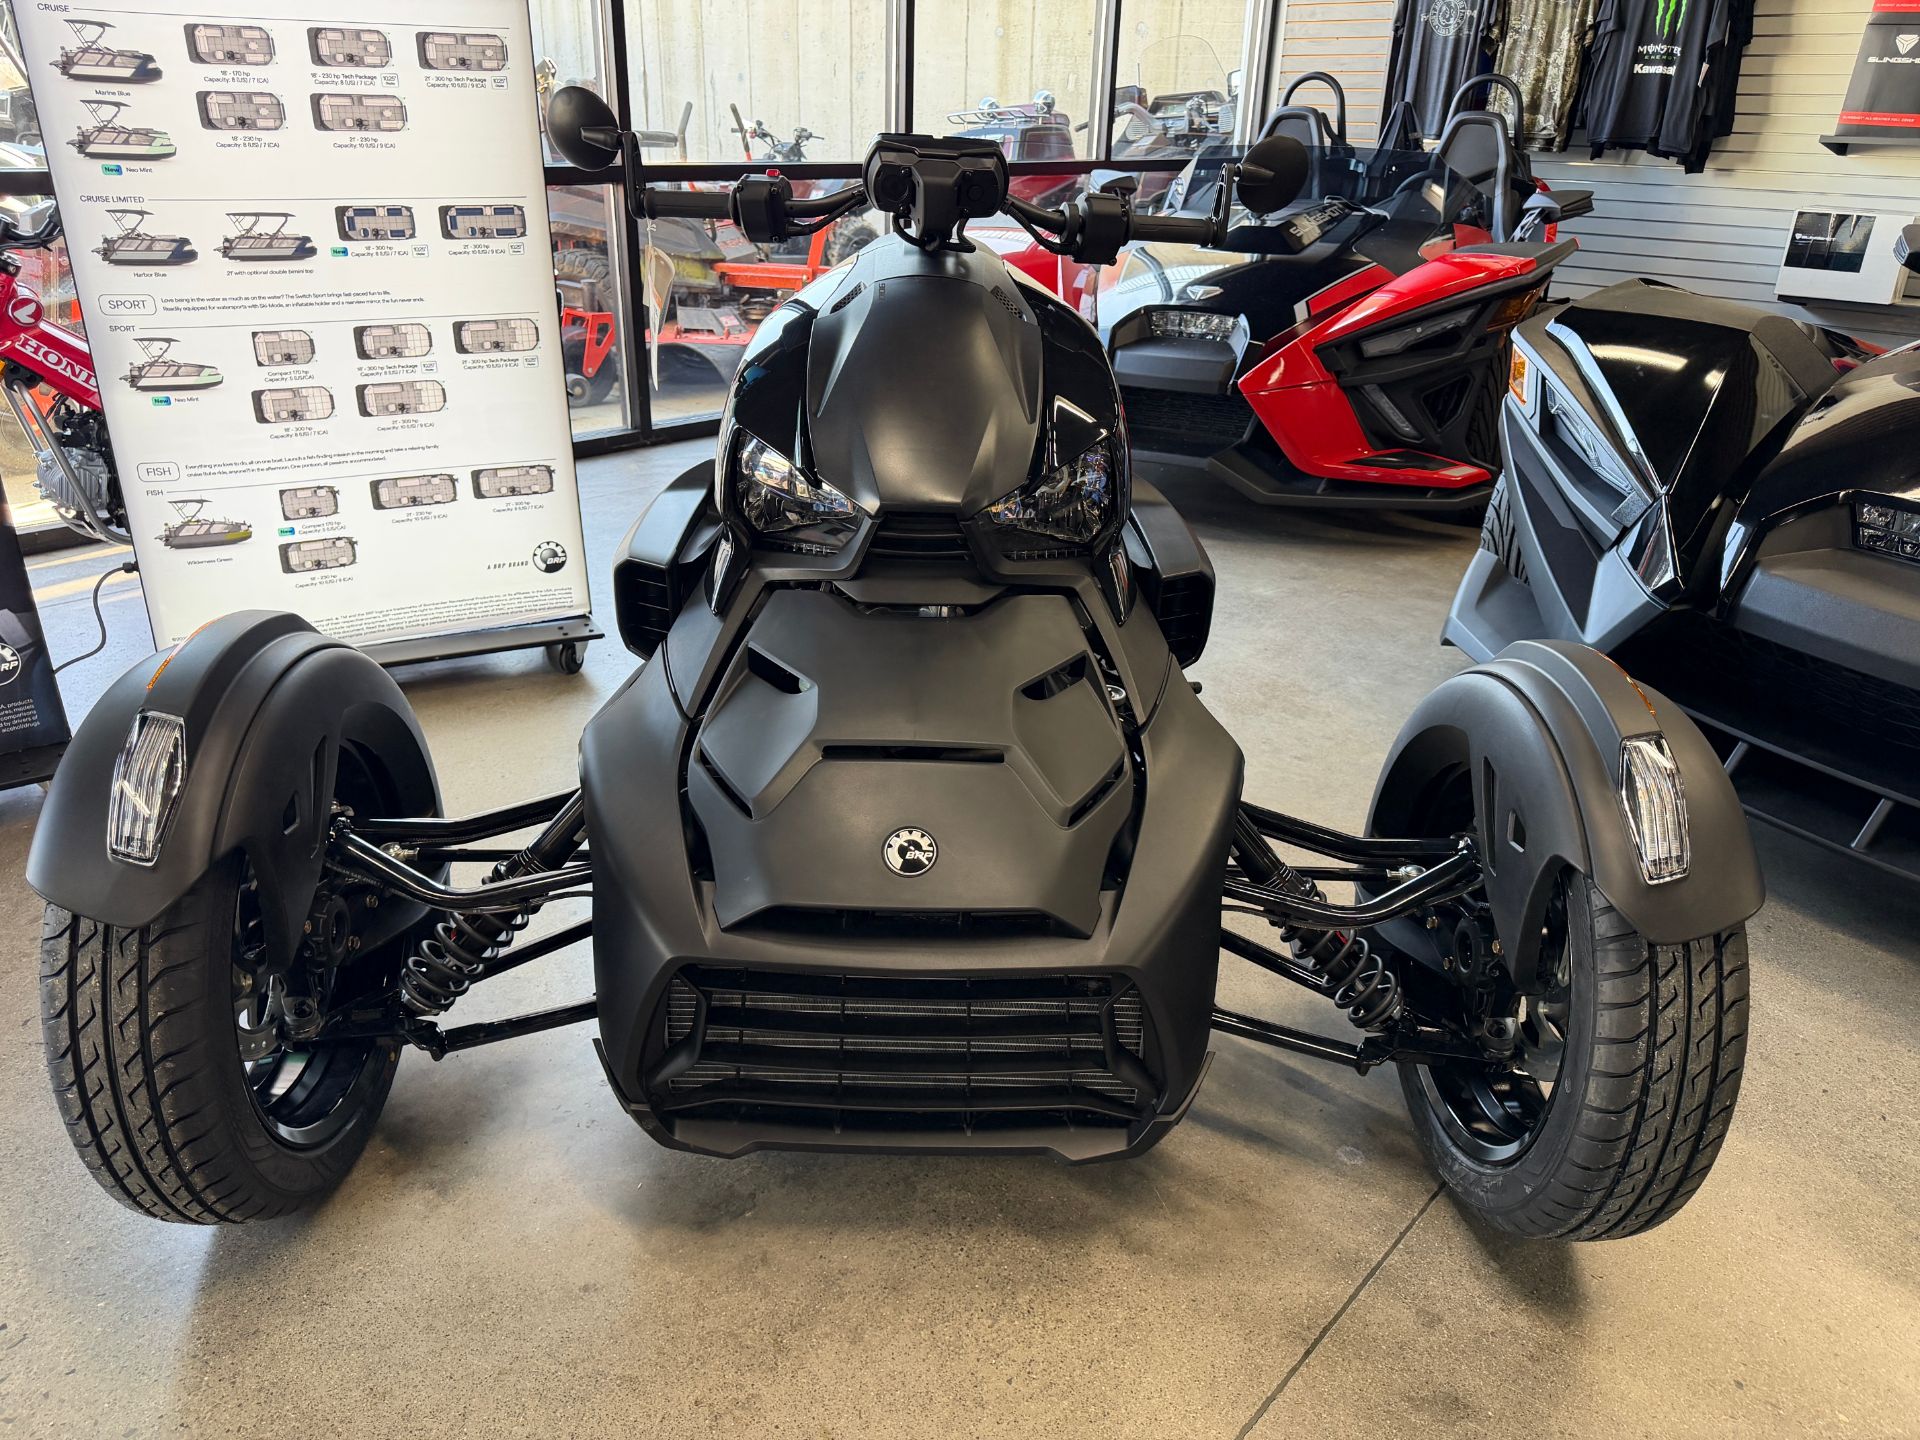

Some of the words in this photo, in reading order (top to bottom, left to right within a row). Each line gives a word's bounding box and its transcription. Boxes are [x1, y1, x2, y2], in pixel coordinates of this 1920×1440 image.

[37, 3, 70, 12] CRUISE
[1633, 63, 1676, 76] Kawasa
[80, 194, 110, 203] CRUISE
[108, 300, 147, 309] SPORT
[15, 333, 99, 392] HOND
[146, 466, 172, 477] FISH
[0, 660, 19, 671] RP
[8, 699, 33, 708] products
[905, 851, 933, 859] BRP
